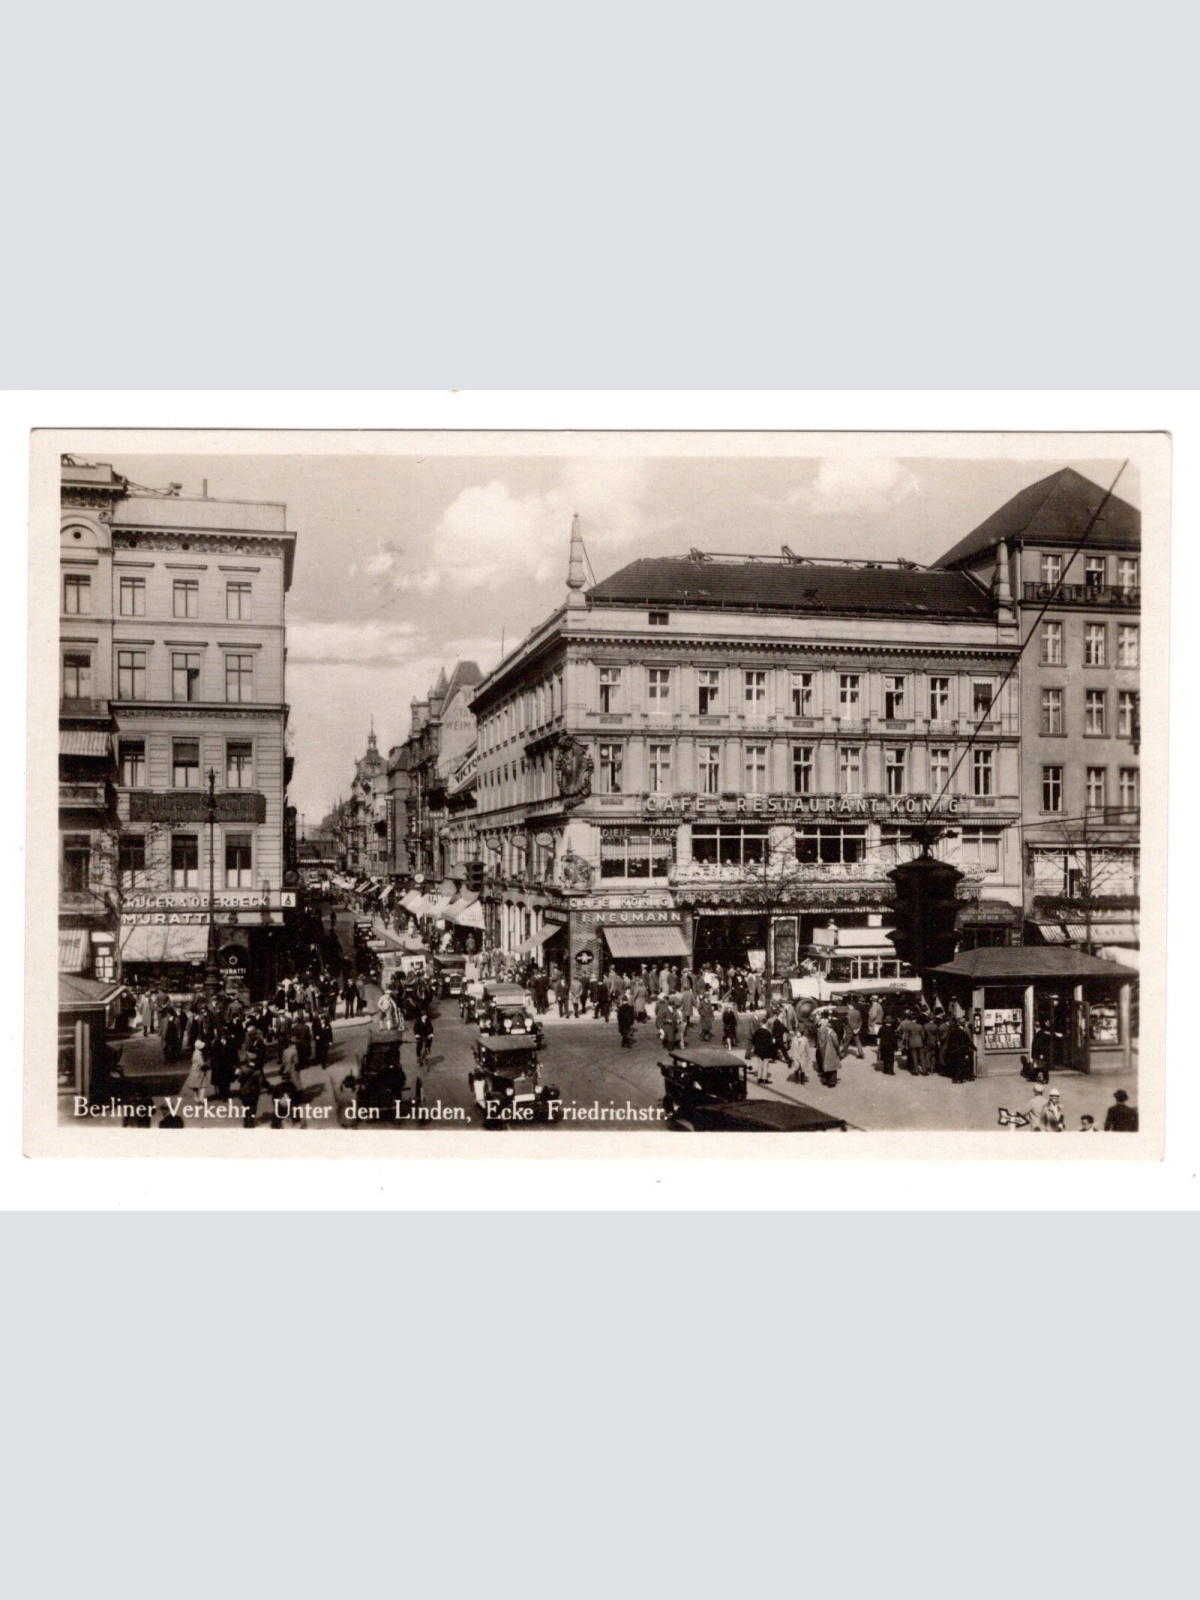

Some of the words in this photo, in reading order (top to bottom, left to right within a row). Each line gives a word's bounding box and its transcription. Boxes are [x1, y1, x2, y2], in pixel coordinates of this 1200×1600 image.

[646, 797, 706, 812] CAFE
[718, 799, 725, 811] &
[737, 797, 878, 812] RESTAURANT
[648, 827, 676, 837] TANZ
[180, 898, 187, 907] &
[192, 897, 267, 907] OBERBECK
[123, 913, 210, 924] MURATTI
[596, 912, 681, 922] NEUMANN
